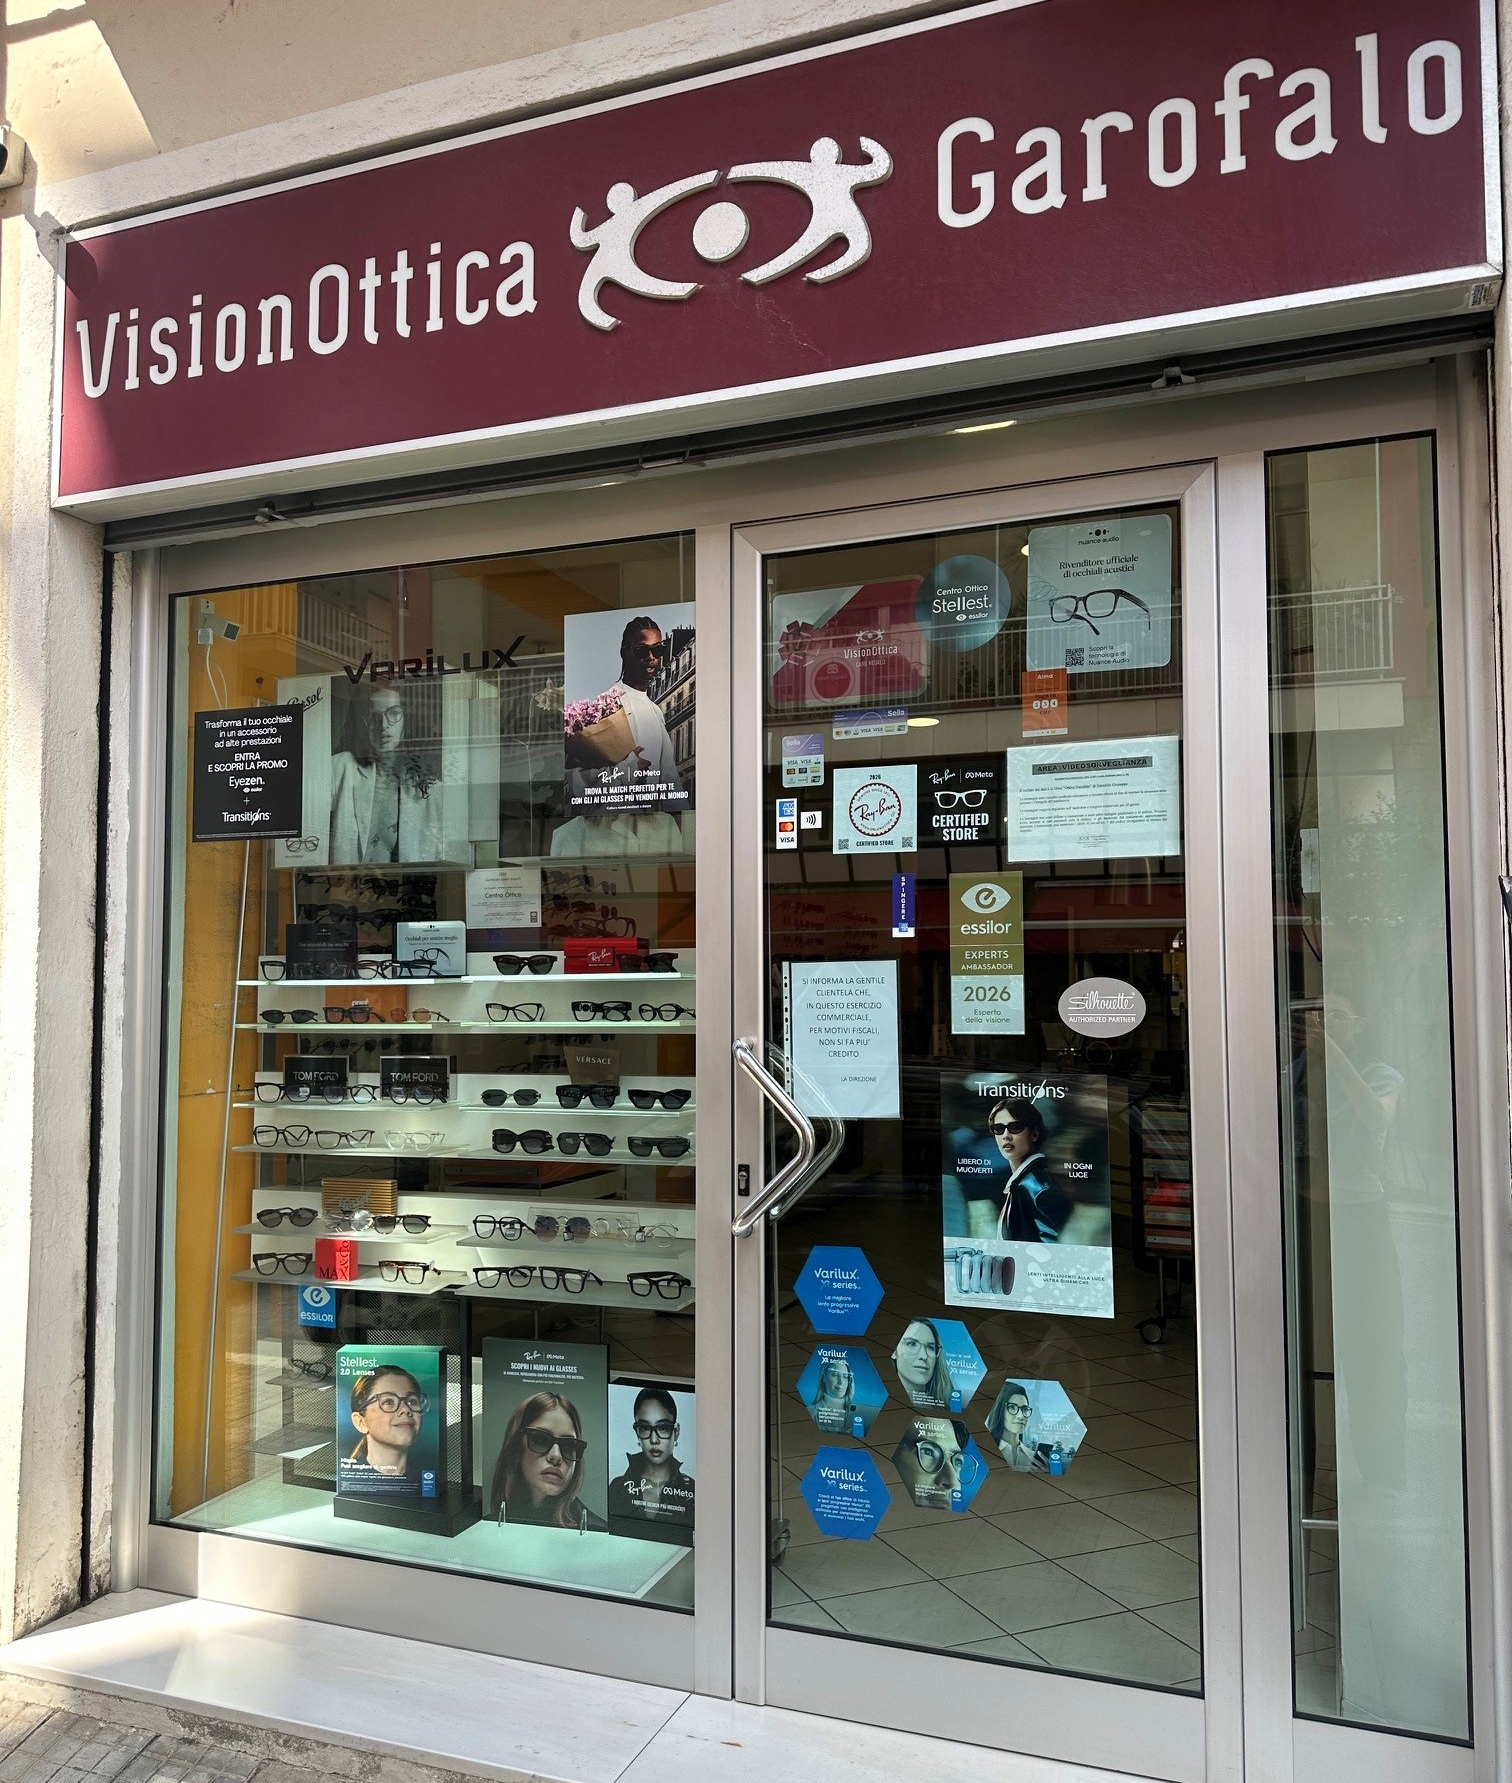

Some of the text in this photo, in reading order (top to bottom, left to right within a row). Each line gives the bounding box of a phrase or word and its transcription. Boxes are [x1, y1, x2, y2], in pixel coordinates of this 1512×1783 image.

[76, 32, 1463, 399] VisionOttica Garofalo
[1102, 536, 1119, 544] audio
[1059, 555, 1138, 569] Rivenditore ufficiale
[1063, 564, 1134, 578] di occhiali acustici
[844, 646, 898, 658] VisionOttica
[205, 720, 241, 728] Trasforma
[263, 715, 292, 724] occhiale
[238, 726, 277, 736] accessorio
[215, 736, 281, 748] ad alte prestazioni
[235, 752, 260, 761] ENTRA
[214, 763, 244, 772] SCOPRI
[245, 762, 255, 770] LA
[257, 760, 288, 769] PROMO
[1062, 759, 1148, 770] VIDEOSORVEGLIANZA
[598, 767, 624, 784] Ray-Ban
[929, 769, 955, 784] Ray-Ban
[609, 786, 627, 794] MATCH
[629, 784, 654, 793] PERFETTO
[601, 795, 623, 803] GLASSES
[625, 793, 634, 802] PIÙ
[636, 793, 658, 801] VENDUTI
[660, 792, 666, 800] AL
[668, 791, 688, 799] MONDO
[854, 798, 896, 821] Ray-Ban
[932, 813, 989, 827] CERTIFIED
[943, 828, 978, 840] STORE
[961, 921, 1012, 934] essilor
[588, 948, 611, 962] Ray-Ban
[965, 950, 1009, 959] EXPERTS
[855, 989, 871, 997] CHE,
[964, 986, 1011, 1002] 2026
[1068, 991, 1135, 1010] Silhouette
[817, 1014, 871, 1022] COMMERCIALE,
[853, 1027, 880, 1035] FISCALI,
[576, 1056, 611, 1064] VERSACE
[293, 1071, 312, 1081] TOM
[390, 1072, 438, 1082] TOM FORD
[624, 1479, 693, 1497] Ray-Ban Meta
